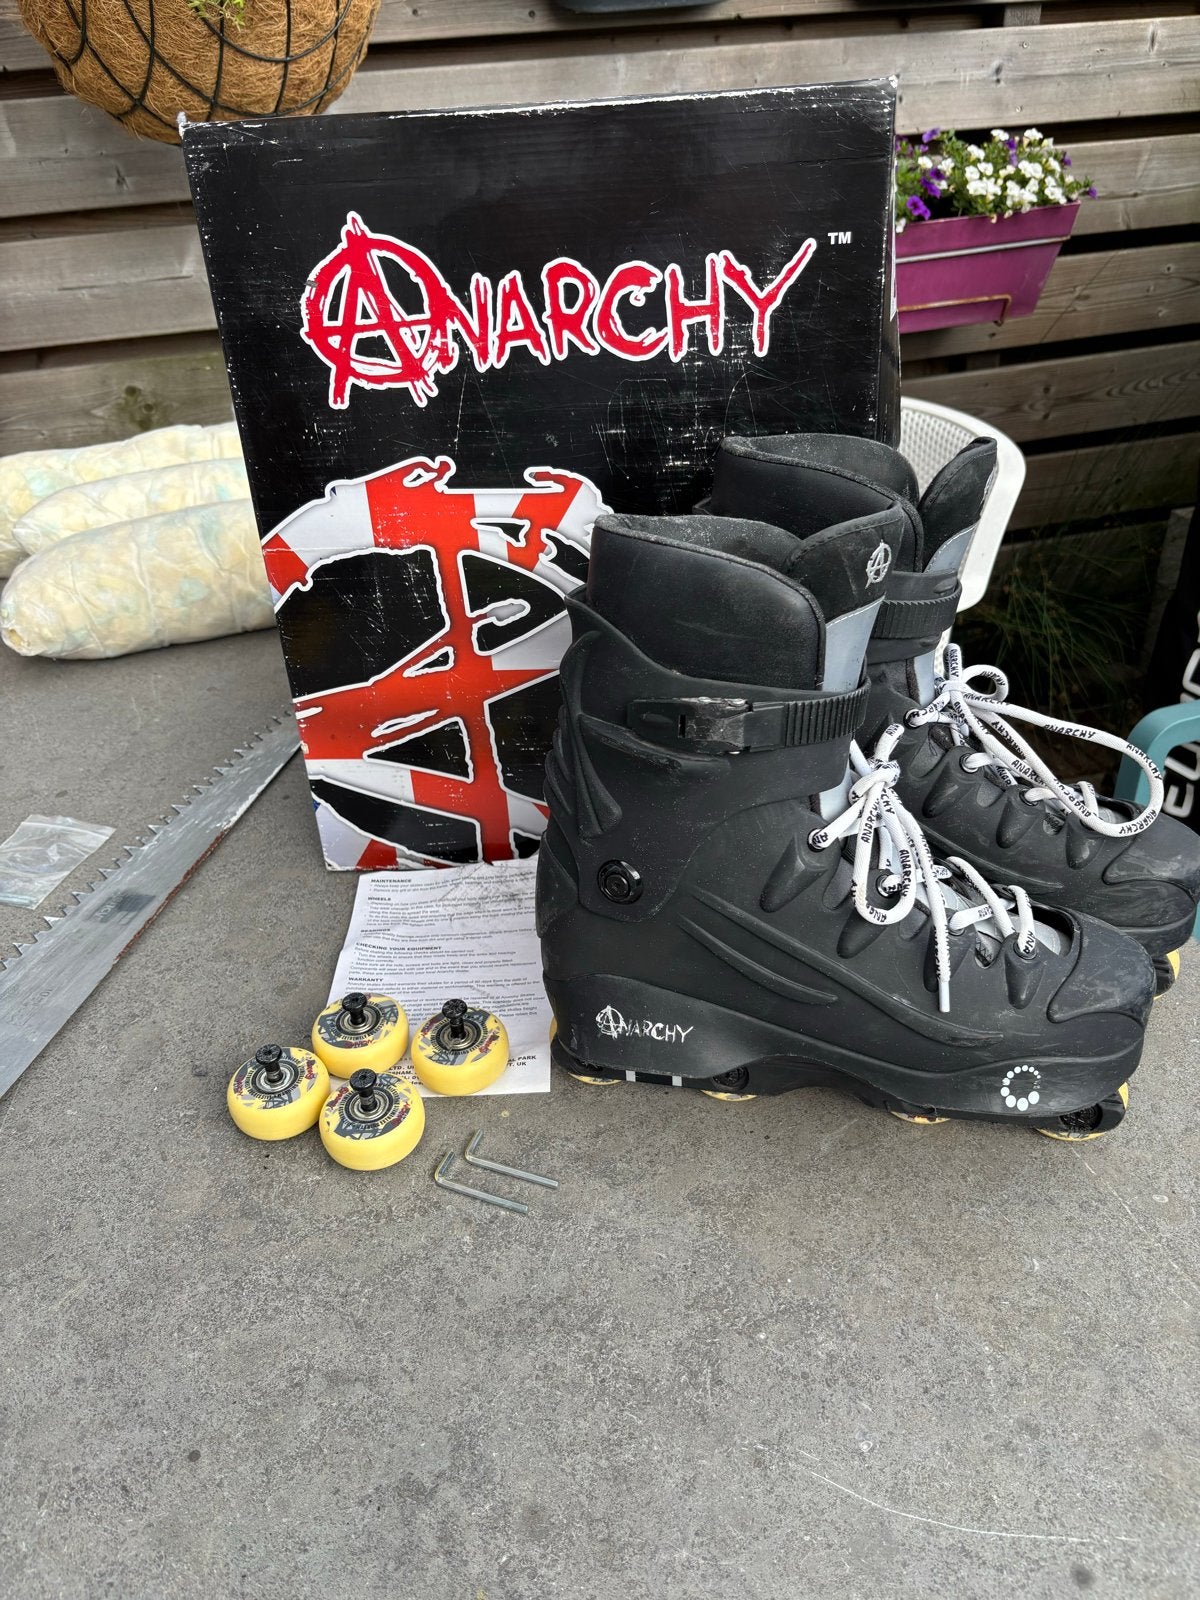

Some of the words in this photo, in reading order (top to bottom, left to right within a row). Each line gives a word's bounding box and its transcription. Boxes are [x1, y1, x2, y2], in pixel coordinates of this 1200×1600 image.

[300, 210, 817, 408] ANARCHY
[827, 231, 852, 245] TM
[1044, 723, 1097, 739] ANARCHY
[1118, 809, 1158, 835] ANARCHY
[899, 848, 912, 898] ANARCHY
[356, 942, 387, 951] CHECKING
[595, 1005, 694, 1043] ANARCHY
